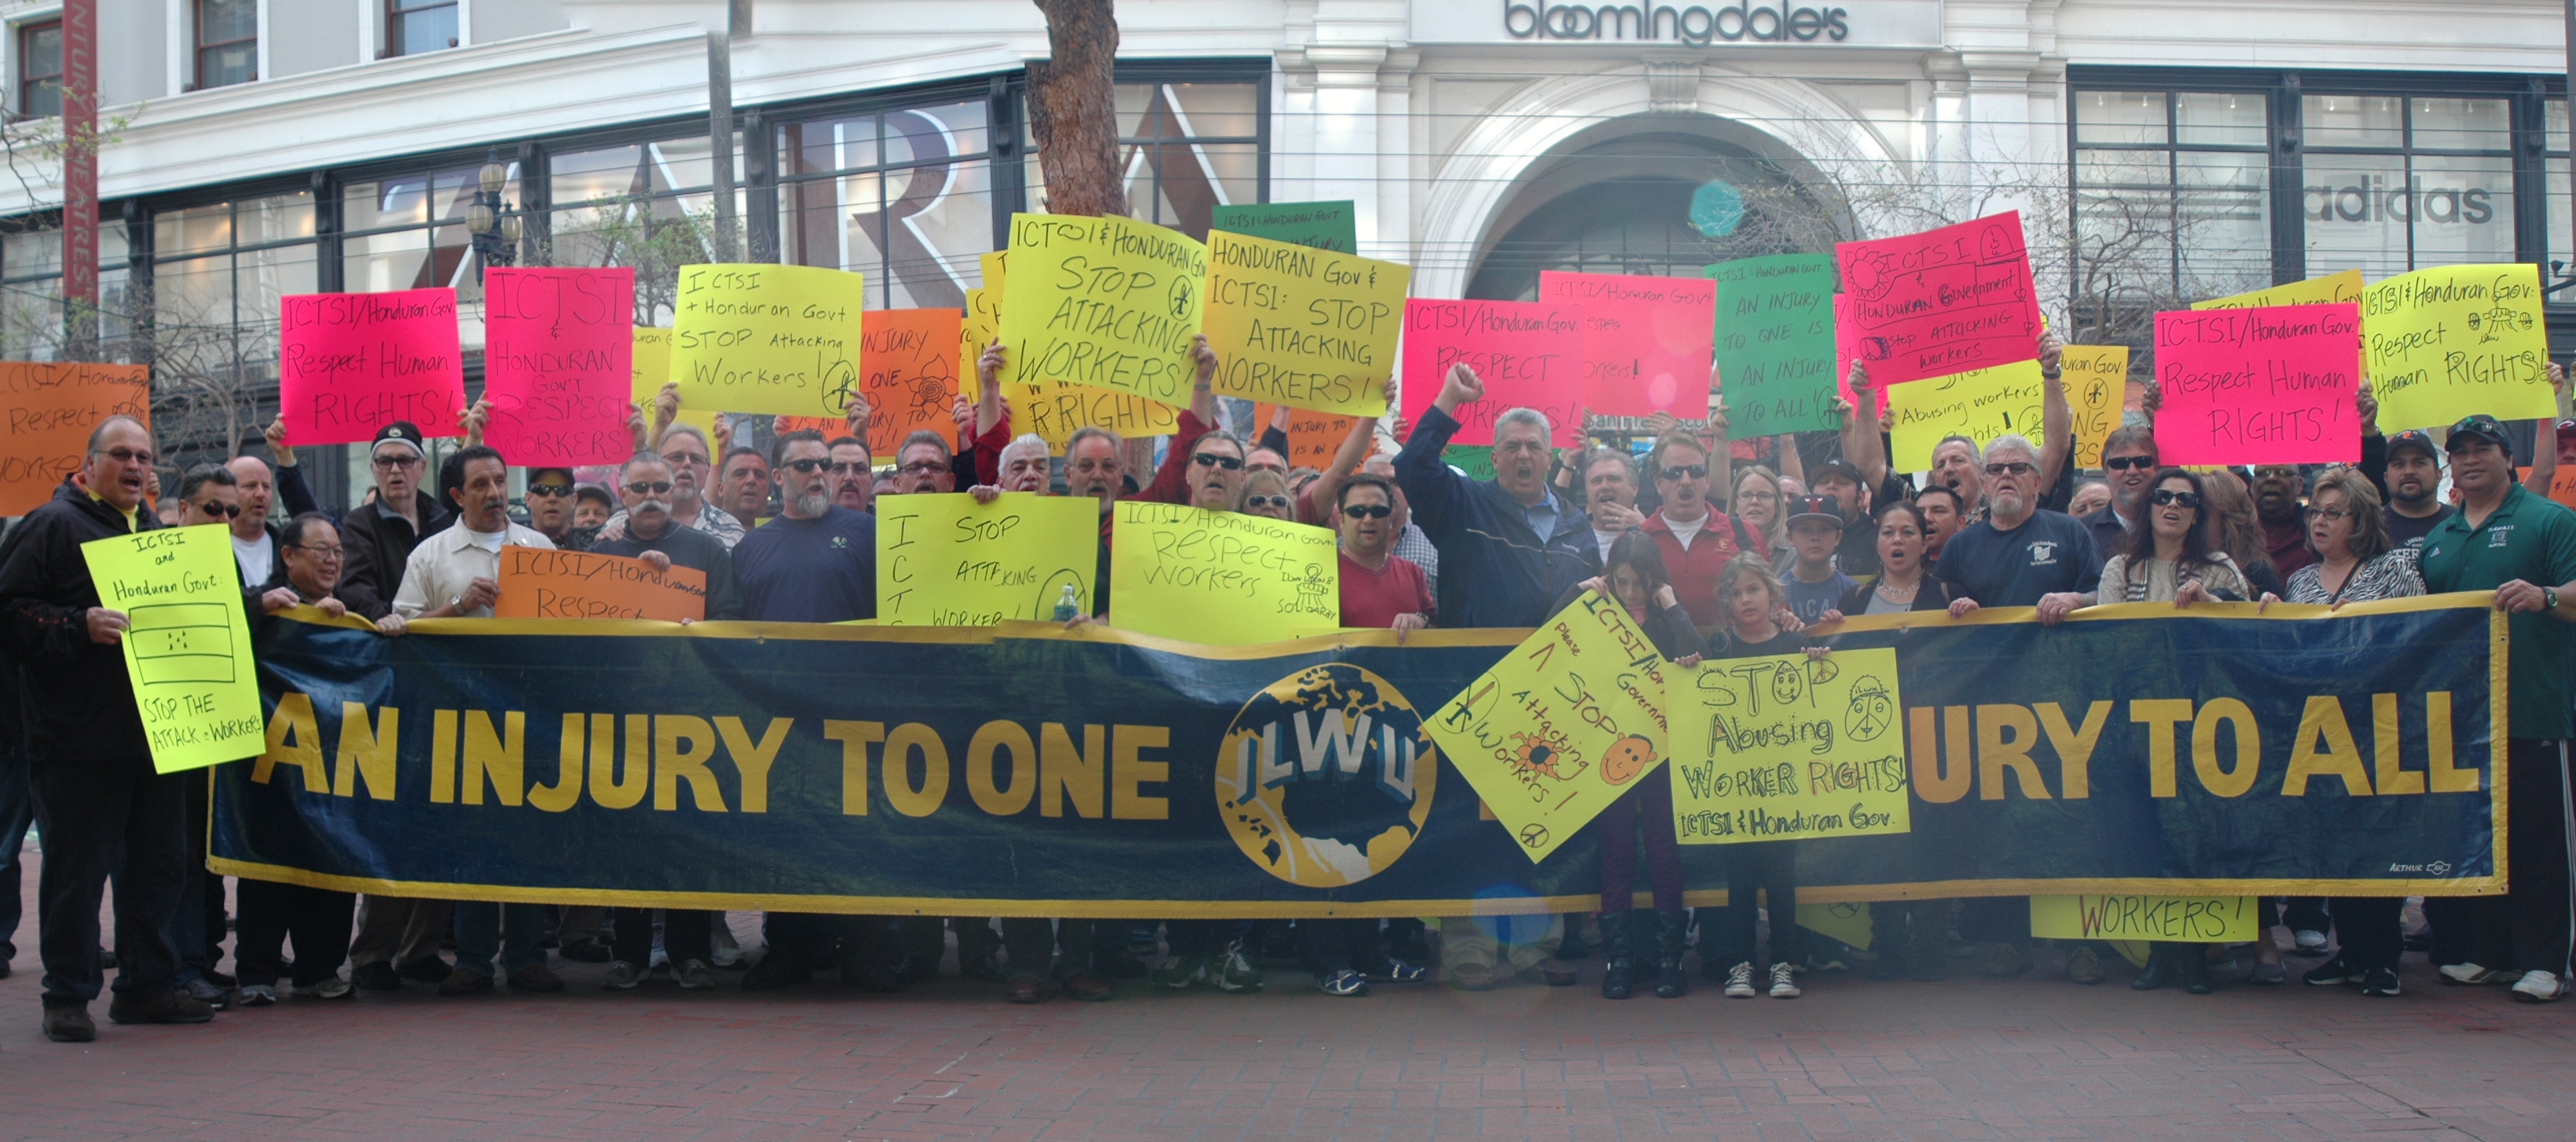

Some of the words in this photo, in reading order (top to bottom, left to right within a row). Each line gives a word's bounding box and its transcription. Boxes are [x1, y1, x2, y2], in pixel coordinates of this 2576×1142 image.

[1504, 0, 1848, 48] bloomingdale's
[2303, 174, 2494, 224] adidas
[1263, 211, 1313, 226] HONDURAN
[1112, 223, 1190, 270] HONDURAN
[1213, 237, 1315, 278] HONDURAN
[1369, 265, 1378, 289] &
[1879, 237, 1970, 274] ICTSI
[1056, 256, 1156, 300] STOP
[1756, 263, 1800, 279] HONDURAN
[492, 272, 628, 325] ICTSI
[1211, 275, 1288, 310] ICTSI:
[1309, 298, 1389, 336] STOP
[1735, 294, 1759, 316] AN
[1768, 292, 1821, 316] INJURY
[1858, 298, 1933, 321] HONDURAN
[1938, 269, 2015, 306] Government
[2414, 276, 2488, 309] Honduran
[803, 303, 846, 322] Govt
[1046, 296, 1191, 360] ATTACKING
[681, 329, 753, 349] STOP
[769, 333, 843, 364] Attacking
[860, 329, 929, 362] INJURY
[1246, 318, 1372, 366] ATTACKING
[1723, 333, 1747, 351] TO
[1759, 323, 1794, 343] ONE
[1808, 320, 1823, 335] IS
[2372, 322, 2447, 366] Respect
[286, 343, 366, 385] Respect
[381, 340, 449, 377] Human
[494, 340, 617, 377] HONDURAN
[1017, 337, 1195, 399] WORKERS!
[1741, 362, 1765, 386] AN
[1776, 357, 1833, 382] INJURY
[870, 368, 901, 388] ONE
[2165, 361, 2256, 403] Respect
[2269, 359, 2346, 396] Human
[2376, 368, 2429, 402] Human
[10, 402, 100, 435] Respect
[494, 393, 630, 428] RESPECT
[1741, 400, 1765, 423] TO
[1902, 399, 1968, 426] Abusing
[494, 428, 624, 461] WORKERS
[131, 532, 186, 553] ICTSI
[955, 515, 1020, 542] STOP
[155, 551, 175, 566] and
[1152, 529, 1297, 571] Respect
[113, 579, 177, 601] Honduran
[1554, 622, 1581, 657] Please
[1554, 671, 1618, 735] STOP
[1697, 658, 1839, 716] STOP
[144, 696, 177, 723] STOP
[183, 693, 215, 715] THE
[152, 725, 200, 752] ATTACK
[209, 714, 263, 743] WORKERS
[1512, 690, 1589, 781] Attacking
[1707, 712, 1834, 758] Abusing
[2130, 698, 2261, 799] TO
[2281, 691, 2480, 796] ALL
[250, 692, 399, 801] AN
[429, 710, 795, 813] INJURY
[824, 719, 949, 817] TO
[966, 720, 1170, 820] ONE
[1237, 708, 1415, 805] ILWU
[1681, 759, 1799, 800] WORKER
[1680, 809, 1735, 837] ICTSI
[1749, 806, 1843, 837] Honduran
[2079, 894, 2243, 939] WORKERS!
